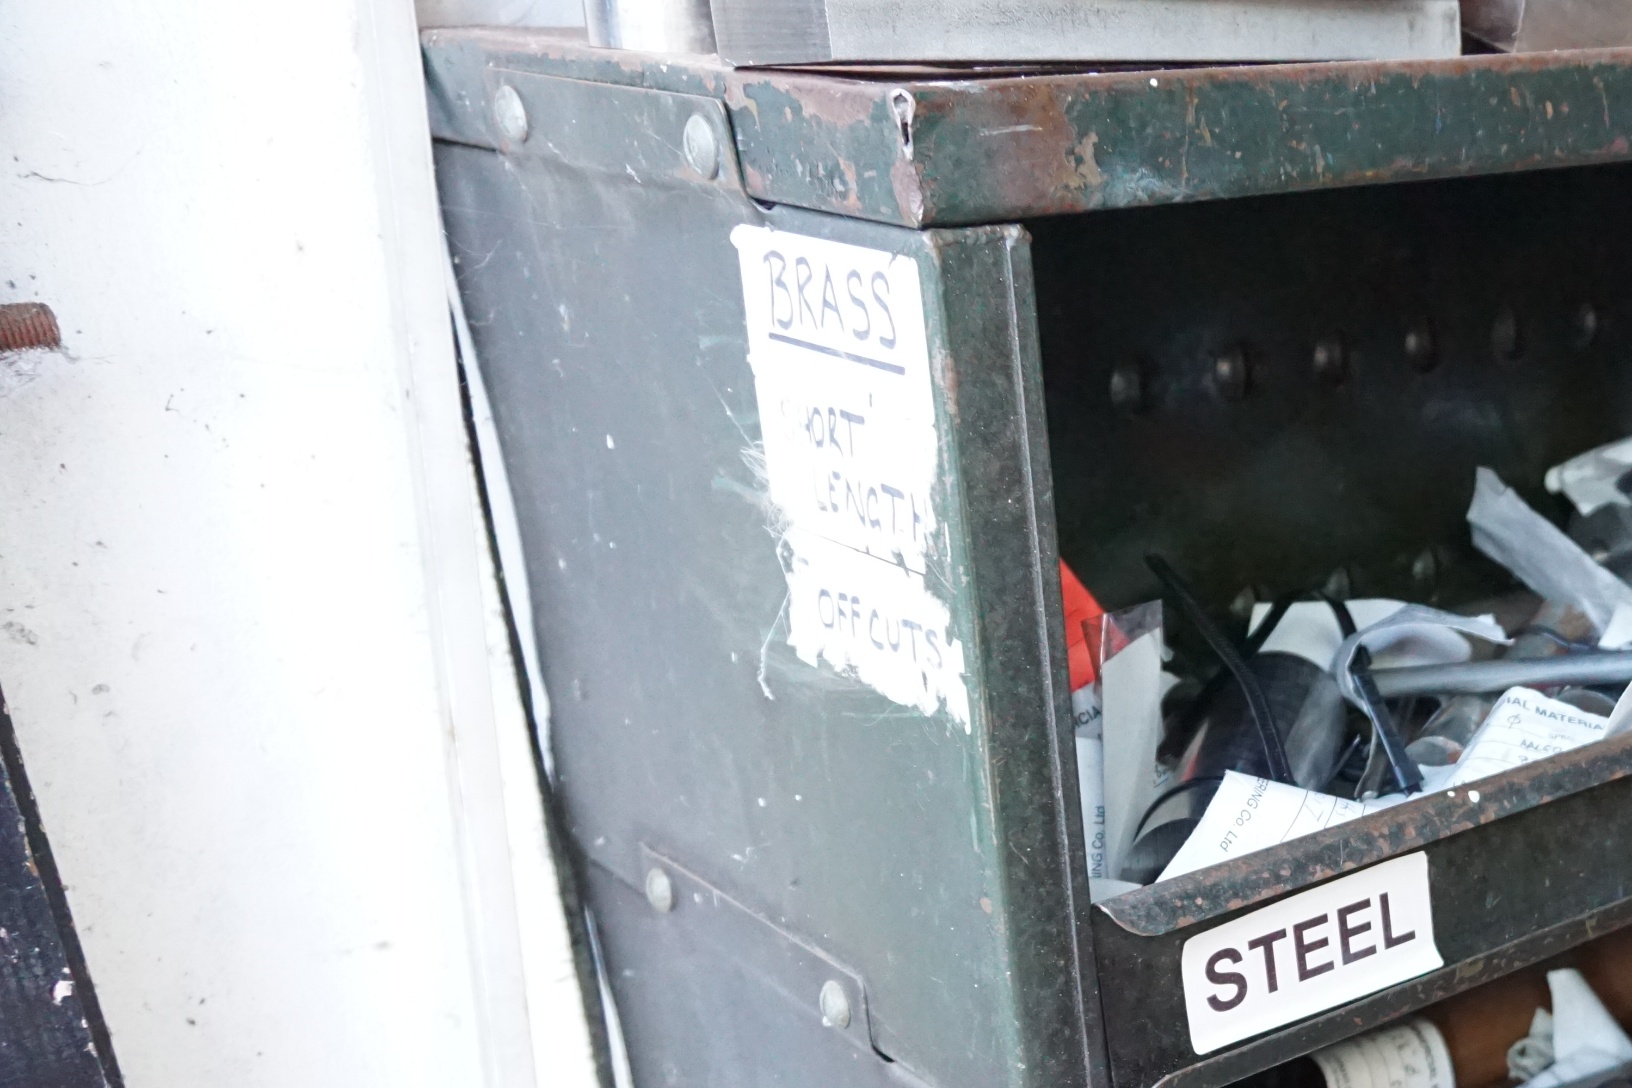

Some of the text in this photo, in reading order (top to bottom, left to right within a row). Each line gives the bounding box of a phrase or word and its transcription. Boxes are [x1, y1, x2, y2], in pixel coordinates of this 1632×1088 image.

[763, 249, 897, 350] BRASS
[1535, 706, 1607, 730] MATERIA
[1093, 806, 1105, 825] Ltd
[1219, 831, 1238, 852] Ltd
[1205, 891, 1416, 1012] STEEL
